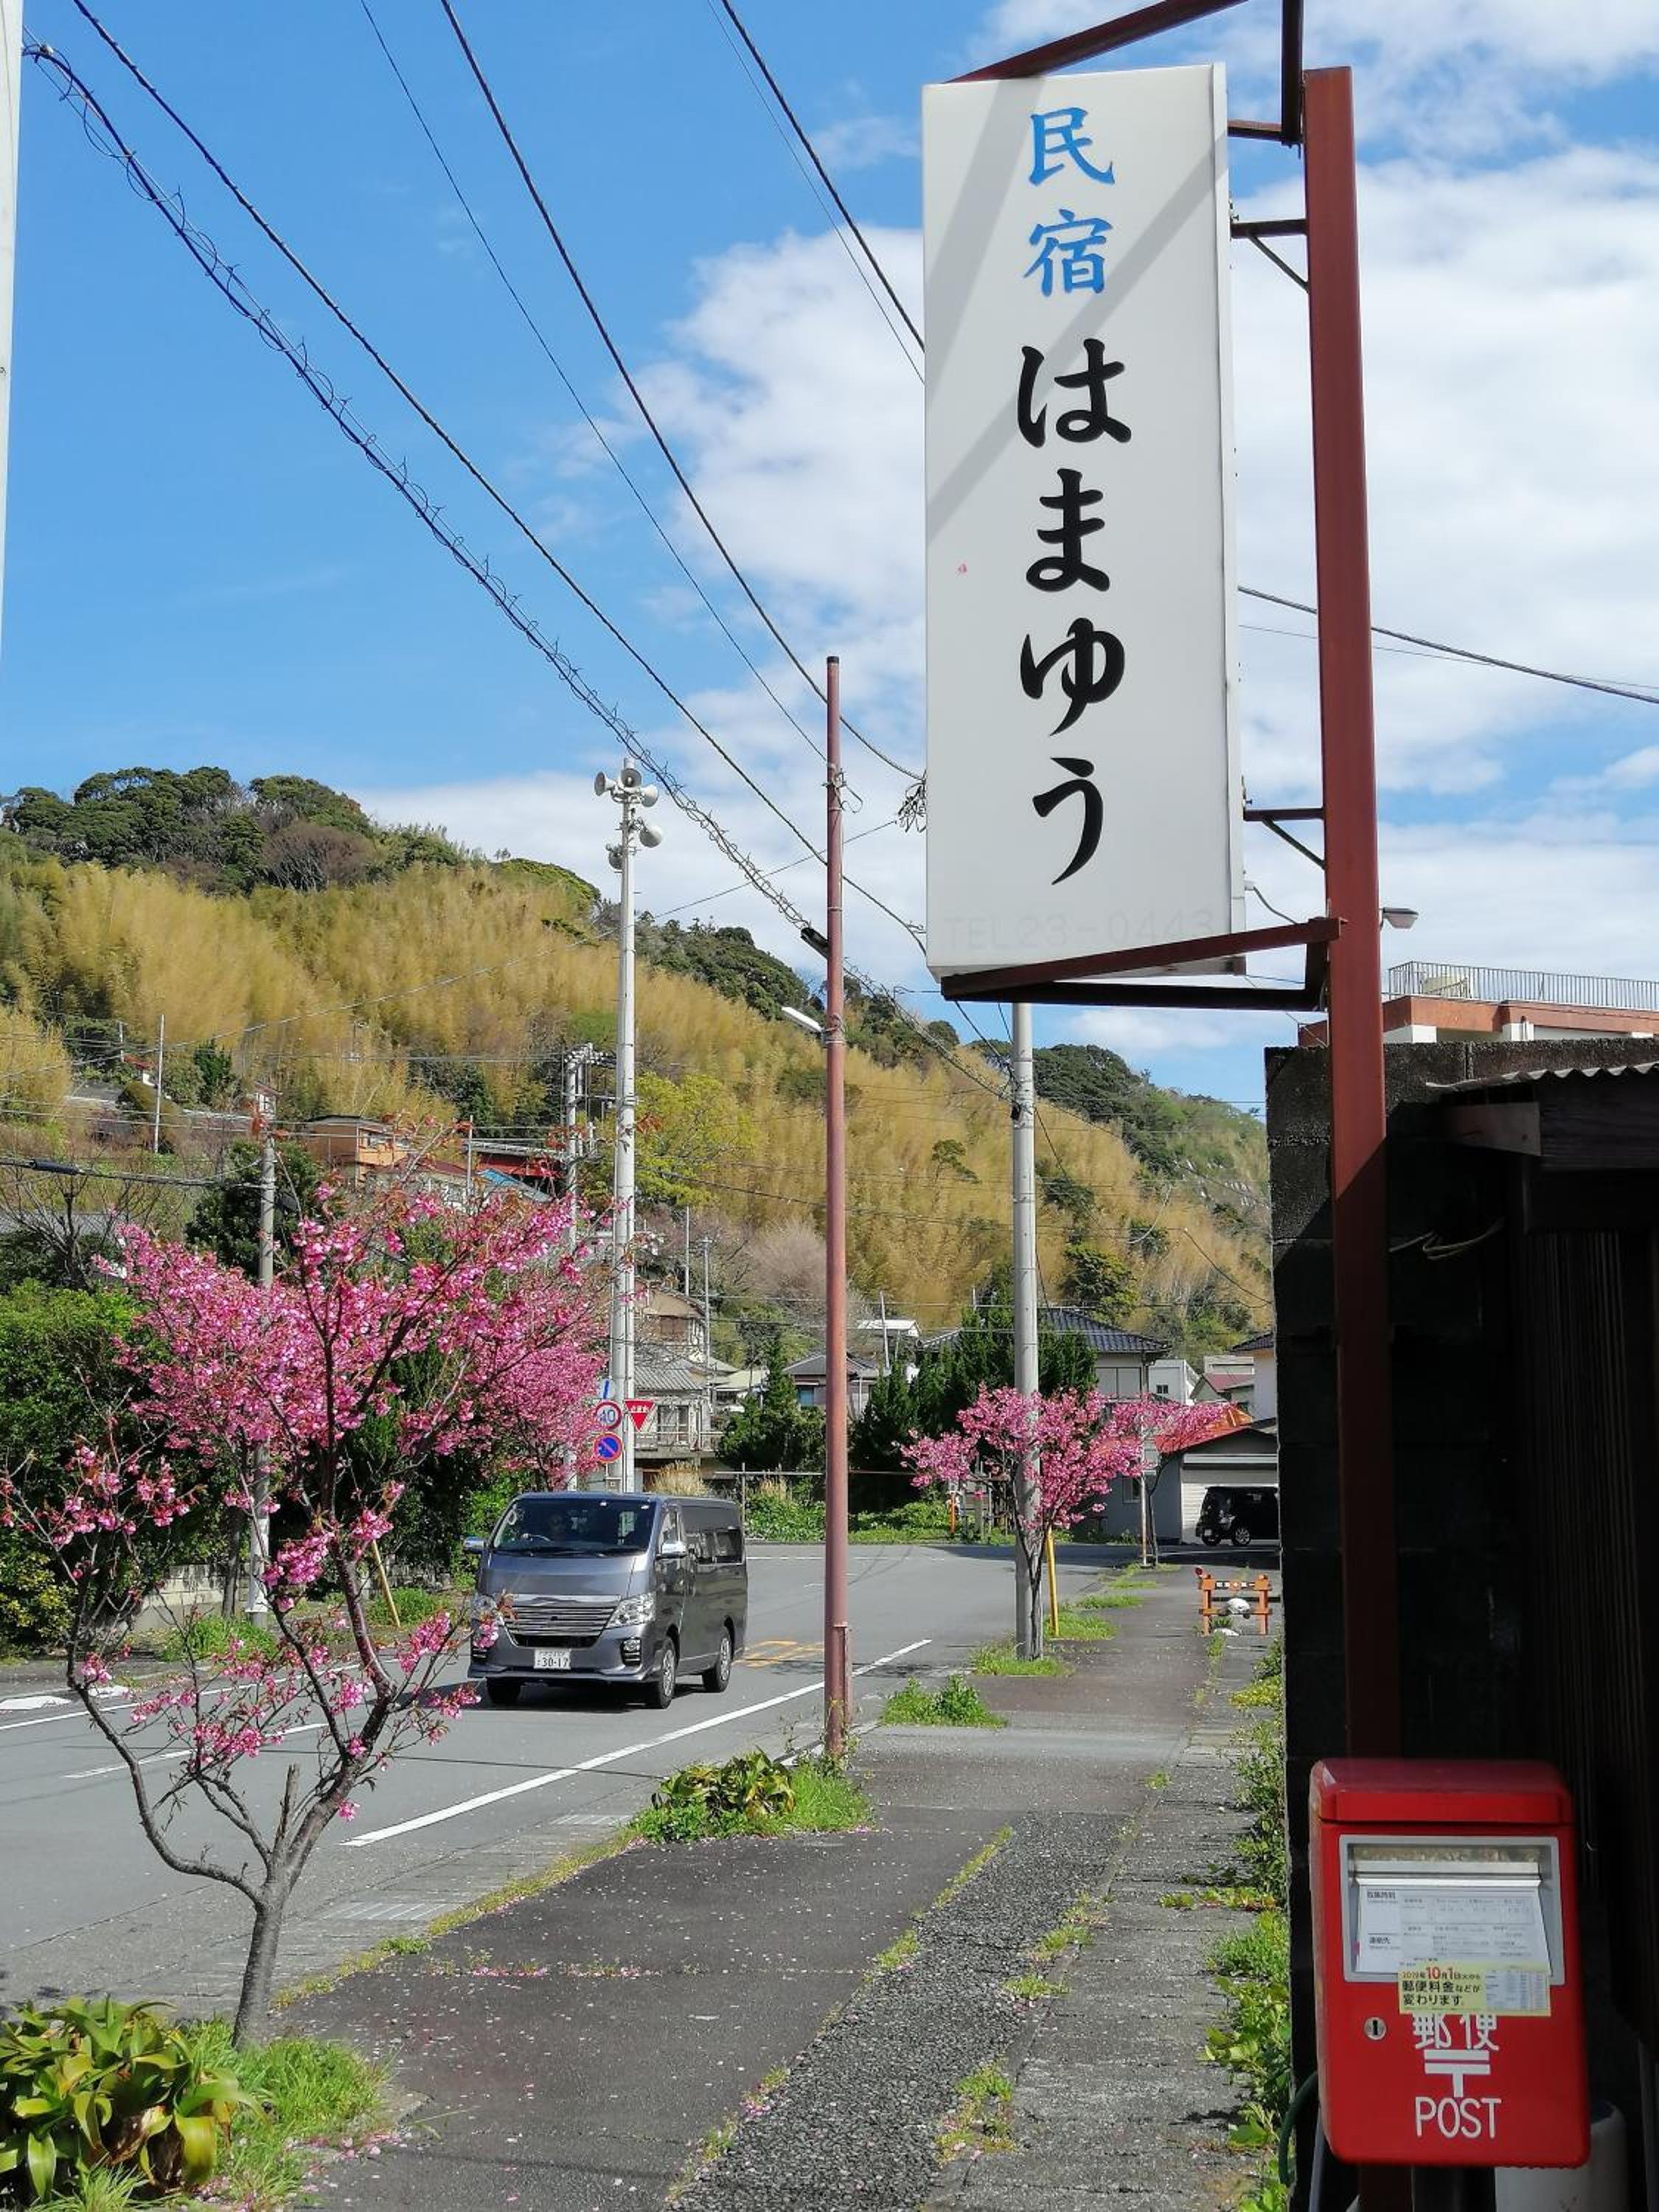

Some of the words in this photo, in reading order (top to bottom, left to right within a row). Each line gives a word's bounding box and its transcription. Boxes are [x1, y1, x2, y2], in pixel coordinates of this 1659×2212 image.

[1026, 106, 1116, 296] 民宿
[1018, 338, 1132, 885] はまゆう
[599, 1409, 616, 1423] 40
[1413, 2013, 1500, 2051] 郵便
[1415, 2096, 1502, 2138] POST
